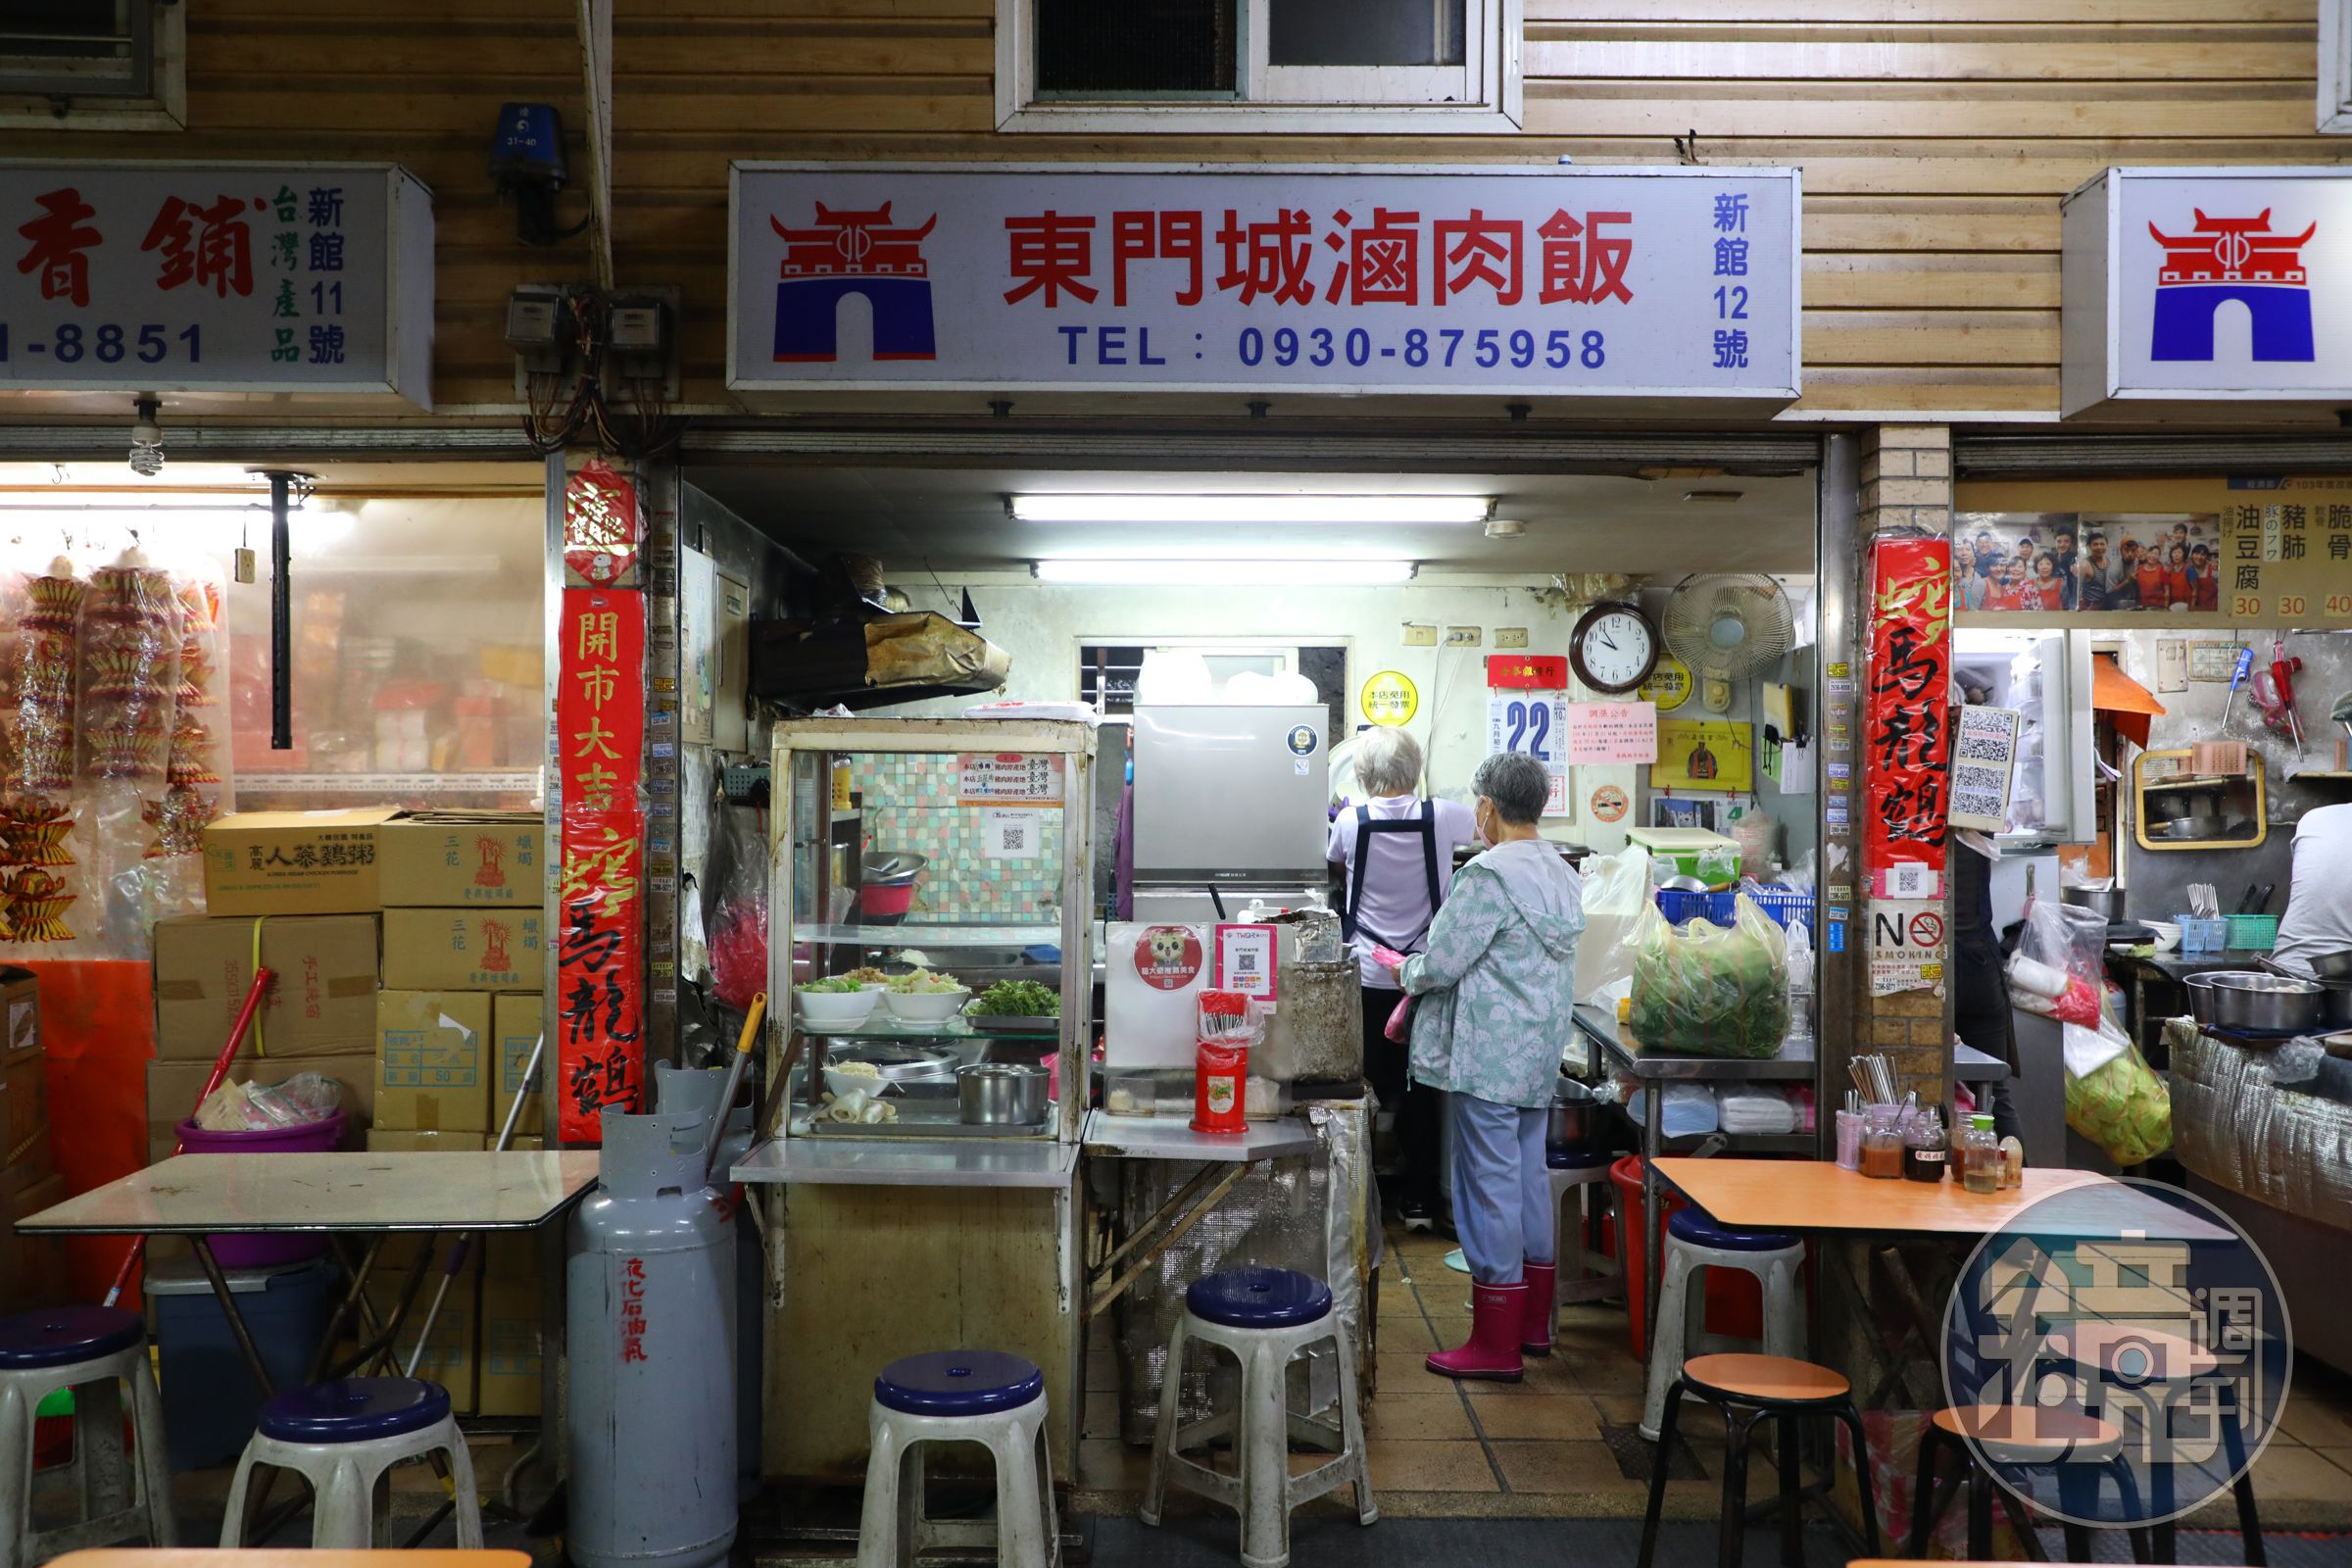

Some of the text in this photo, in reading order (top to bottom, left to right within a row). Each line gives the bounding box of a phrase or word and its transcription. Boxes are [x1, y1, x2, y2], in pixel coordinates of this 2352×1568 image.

[270, 185, 301, 364] 台灣產品
[308, 187, 345, 365] 新館11號
[1002, 206, 1636, 310] 東門城滷肉飯
[1712, 192, 1750, 369] 新館12號
[1237, 324, 1608, 368] 0930-875958
[2234, 504, 2261, 591] 油豆腐
[2328, 504, 2352, 560] 脆骨
[2234, 597, 2261, 615] 30
[2280, 597, 2306, 615] 30
[2326, 595, 2352, 613] 40
[572, 610, 623, 812] 開市大吉
[1507, 701, 1550, 761] 22
[1026, 758, 1050, 771] 臺灣
[1026, 770, 1050, 783] 臺灣
[1026, 783, 1050, 796] 臺灣
[249, 845, 264, 870] 高麗
[445, 835, 461, 866] 三花
[452, 918, 466, 951] 三花
[620, 1256, 648, 1364] 液化石油氣
